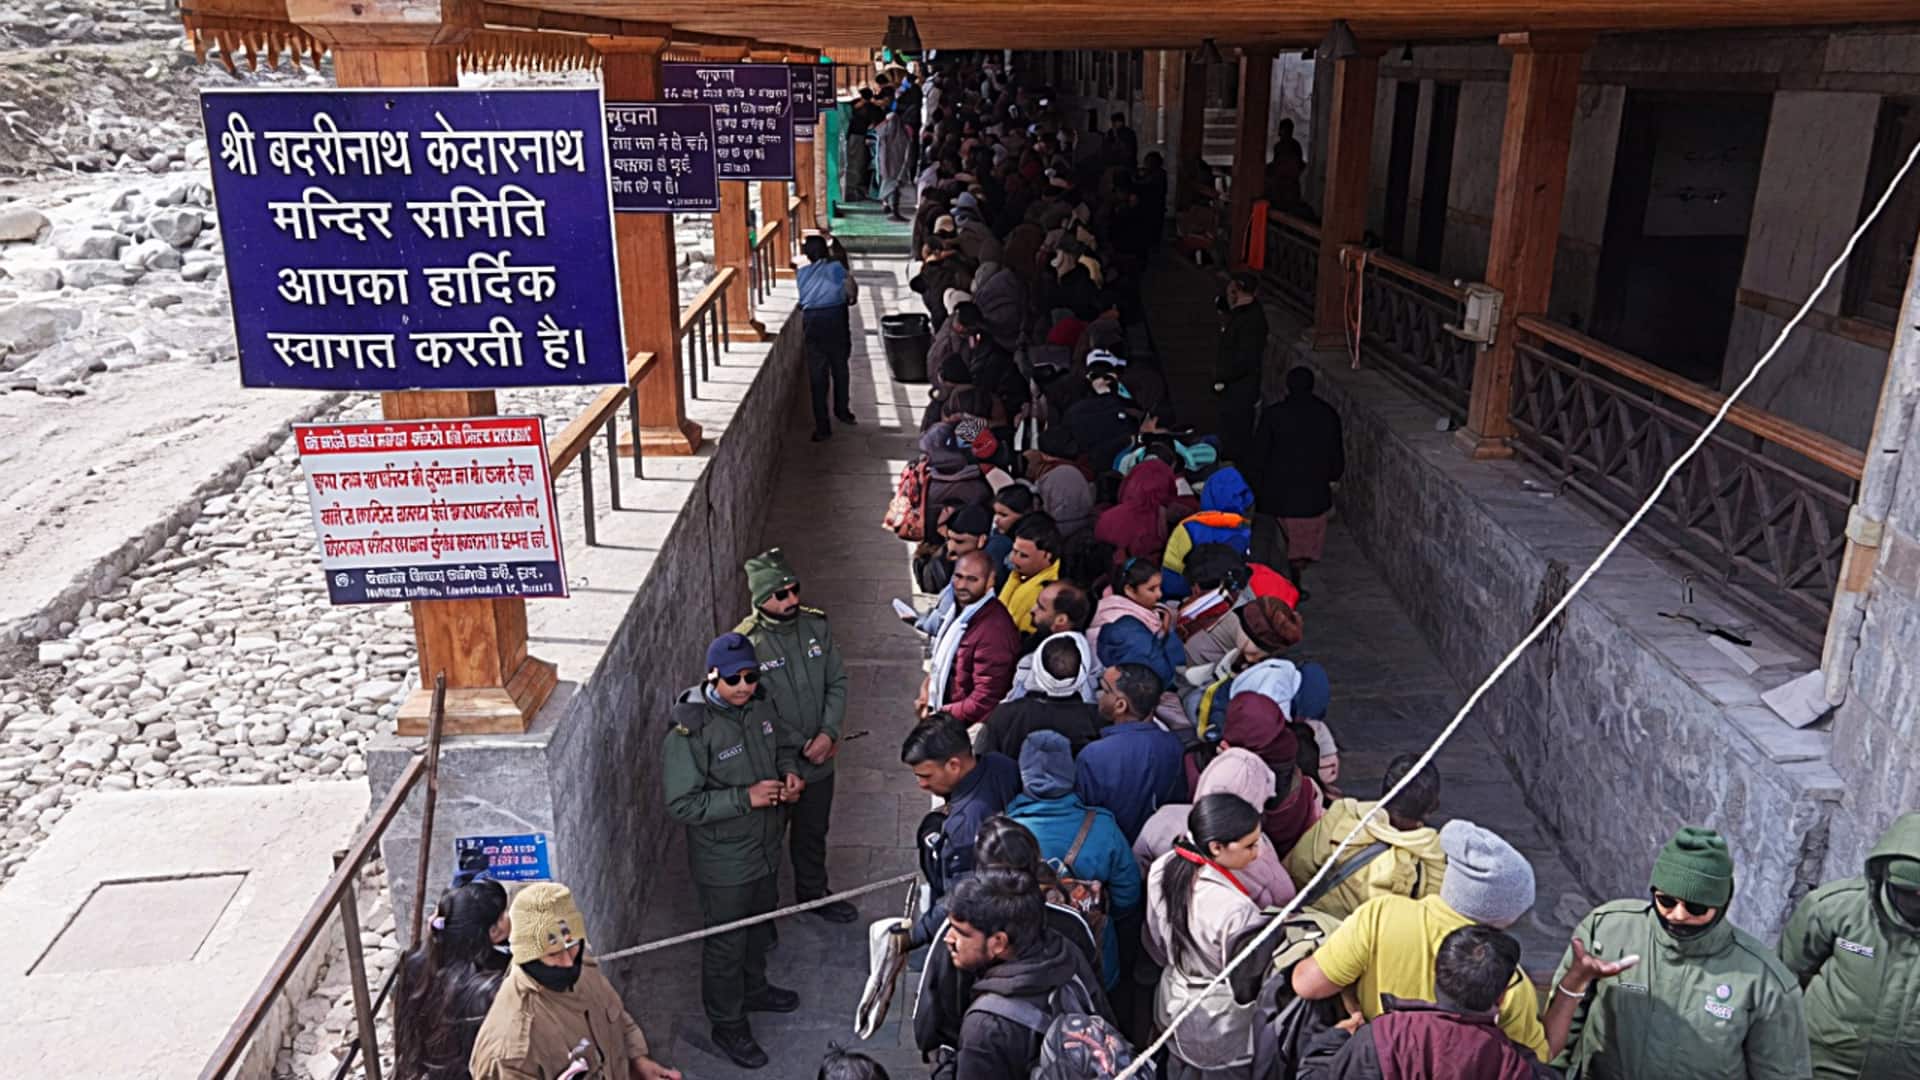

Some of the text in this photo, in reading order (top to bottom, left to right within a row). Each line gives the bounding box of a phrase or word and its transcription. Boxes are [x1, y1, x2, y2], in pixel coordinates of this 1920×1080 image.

[220, 111, 585, 176] श्री बदरीनाथ केदारनाथ
[268, 184, 546, 241] मन्दिर समिति
[277, 250, 556, 307] आपका हार्दिक
[266, 314, 586, 369] स्वागत करती है।
